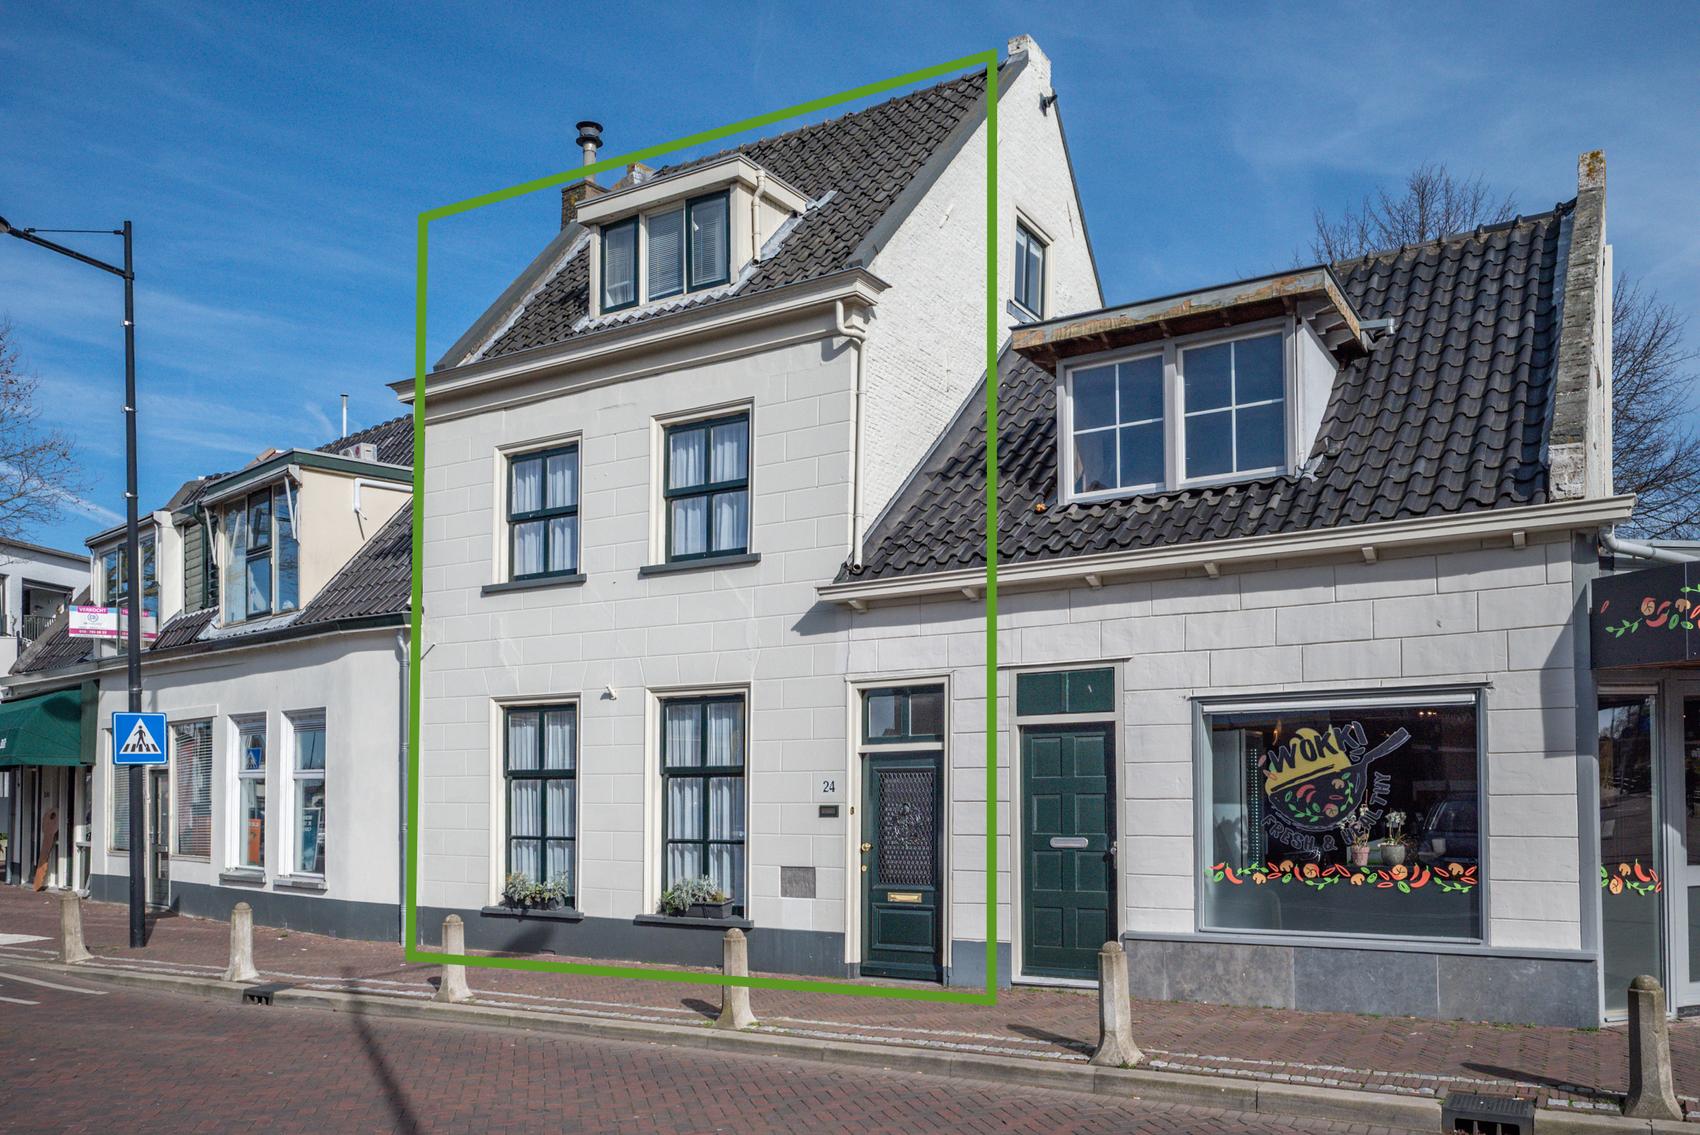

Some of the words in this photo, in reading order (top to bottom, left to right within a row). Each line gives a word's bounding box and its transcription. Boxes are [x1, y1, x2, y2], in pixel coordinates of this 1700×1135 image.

[822, 780, 836, 793] 24
[1261, 814, 1317, 852] FRESH
[1322, 834, 1339, 852] &
